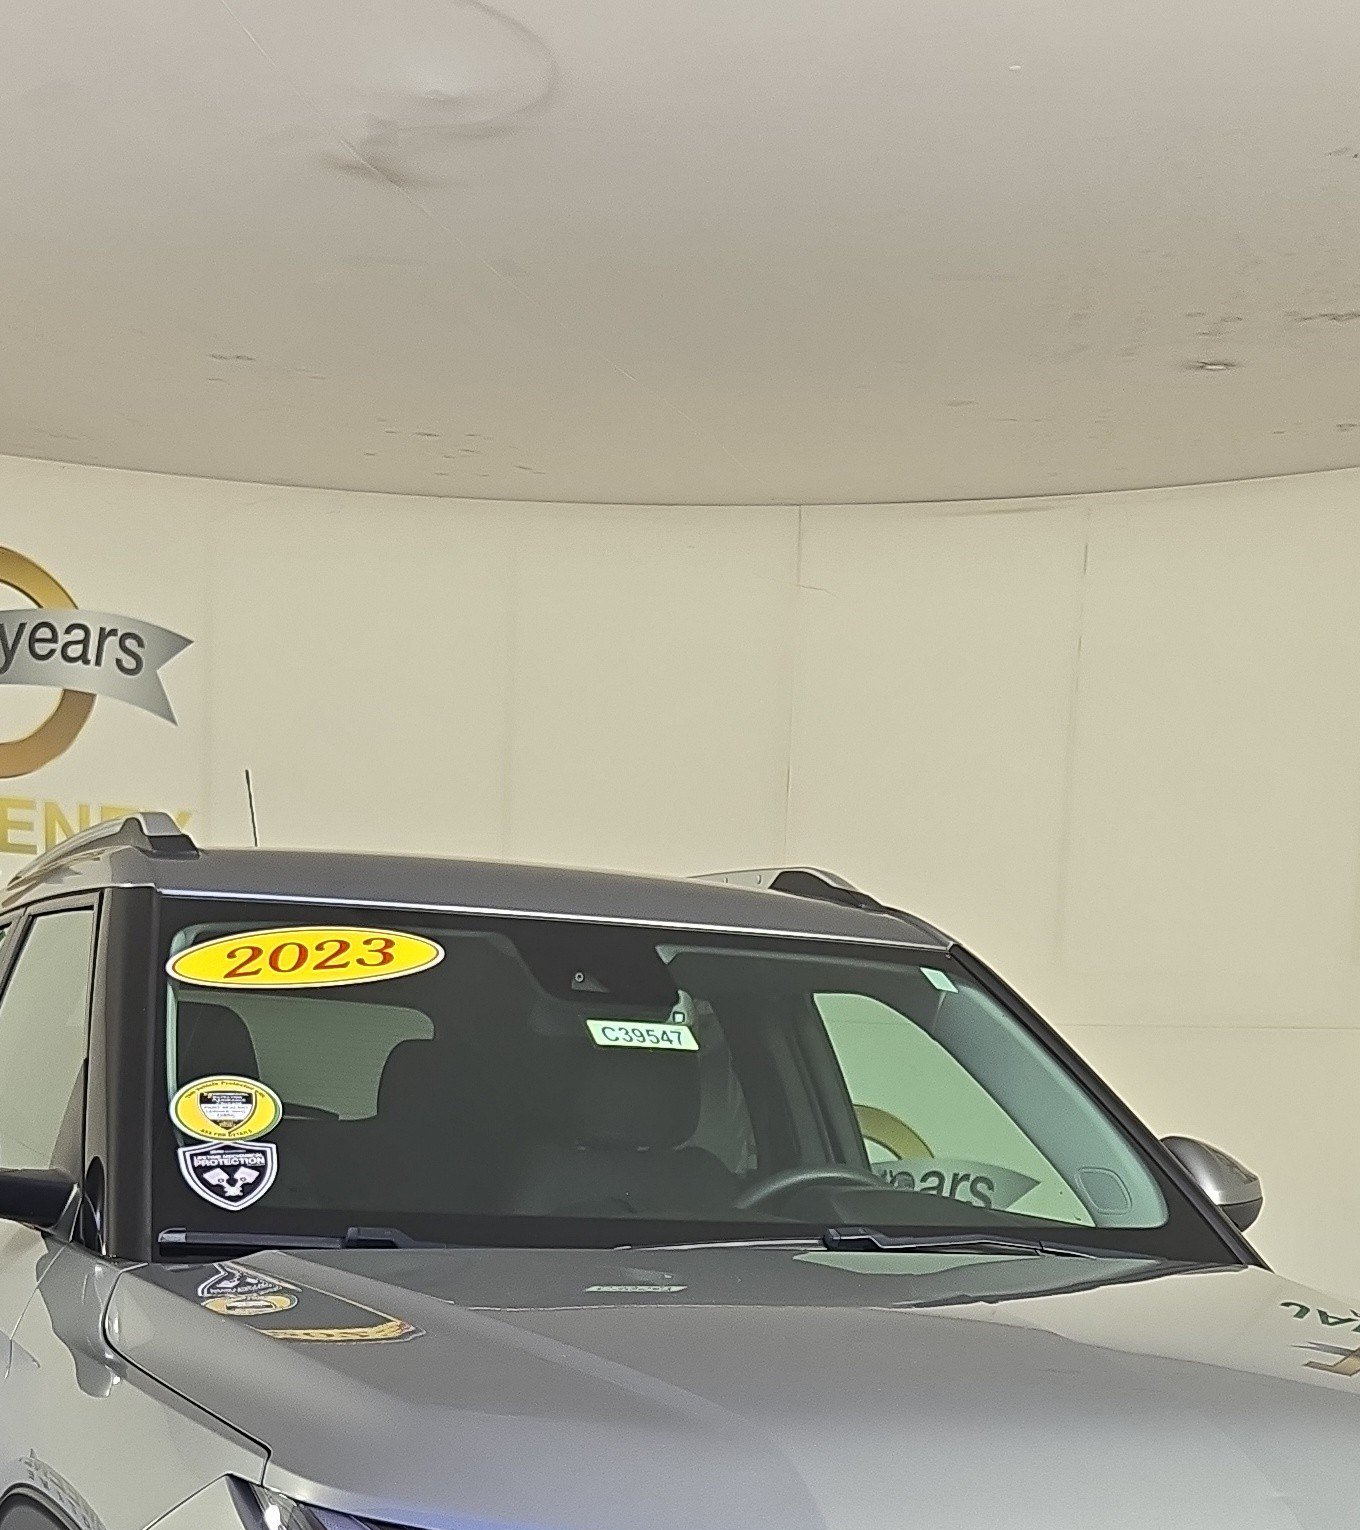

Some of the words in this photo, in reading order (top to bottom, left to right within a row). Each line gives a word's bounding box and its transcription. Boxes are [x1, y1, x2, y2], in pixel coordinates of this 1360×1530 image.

[223, 937, 396, 979] 2023
[601, 1026, 682, 1046] C39547
[193, 1157, 266, 1167] PROTECTION
